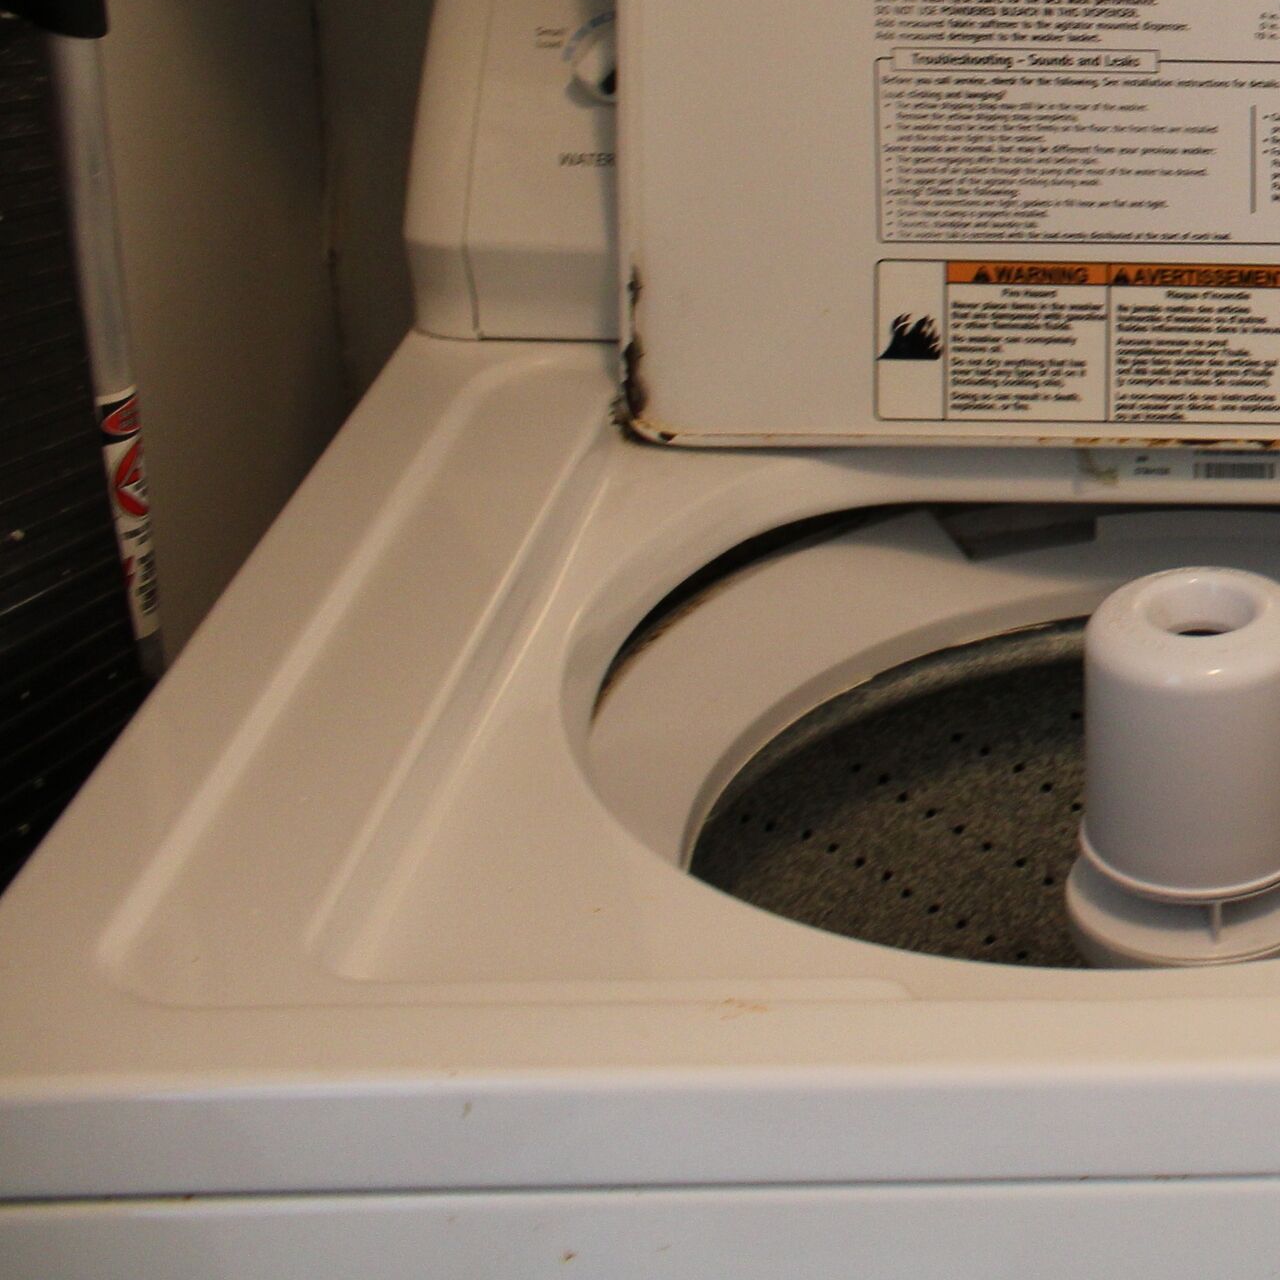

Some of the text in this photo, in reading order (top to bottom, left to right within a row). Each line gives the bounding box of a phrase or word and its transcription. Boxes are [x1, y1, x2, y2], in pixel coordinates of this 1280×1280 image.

[912, 51, 1014, 68] Troubleshooting
[1026, 52, 1074, 65] Sounds
[1076, 52, 1101, 65] and
[1104, 52, 1140, 66] Leaks
[995, 267, 1089, 283] WARNING
